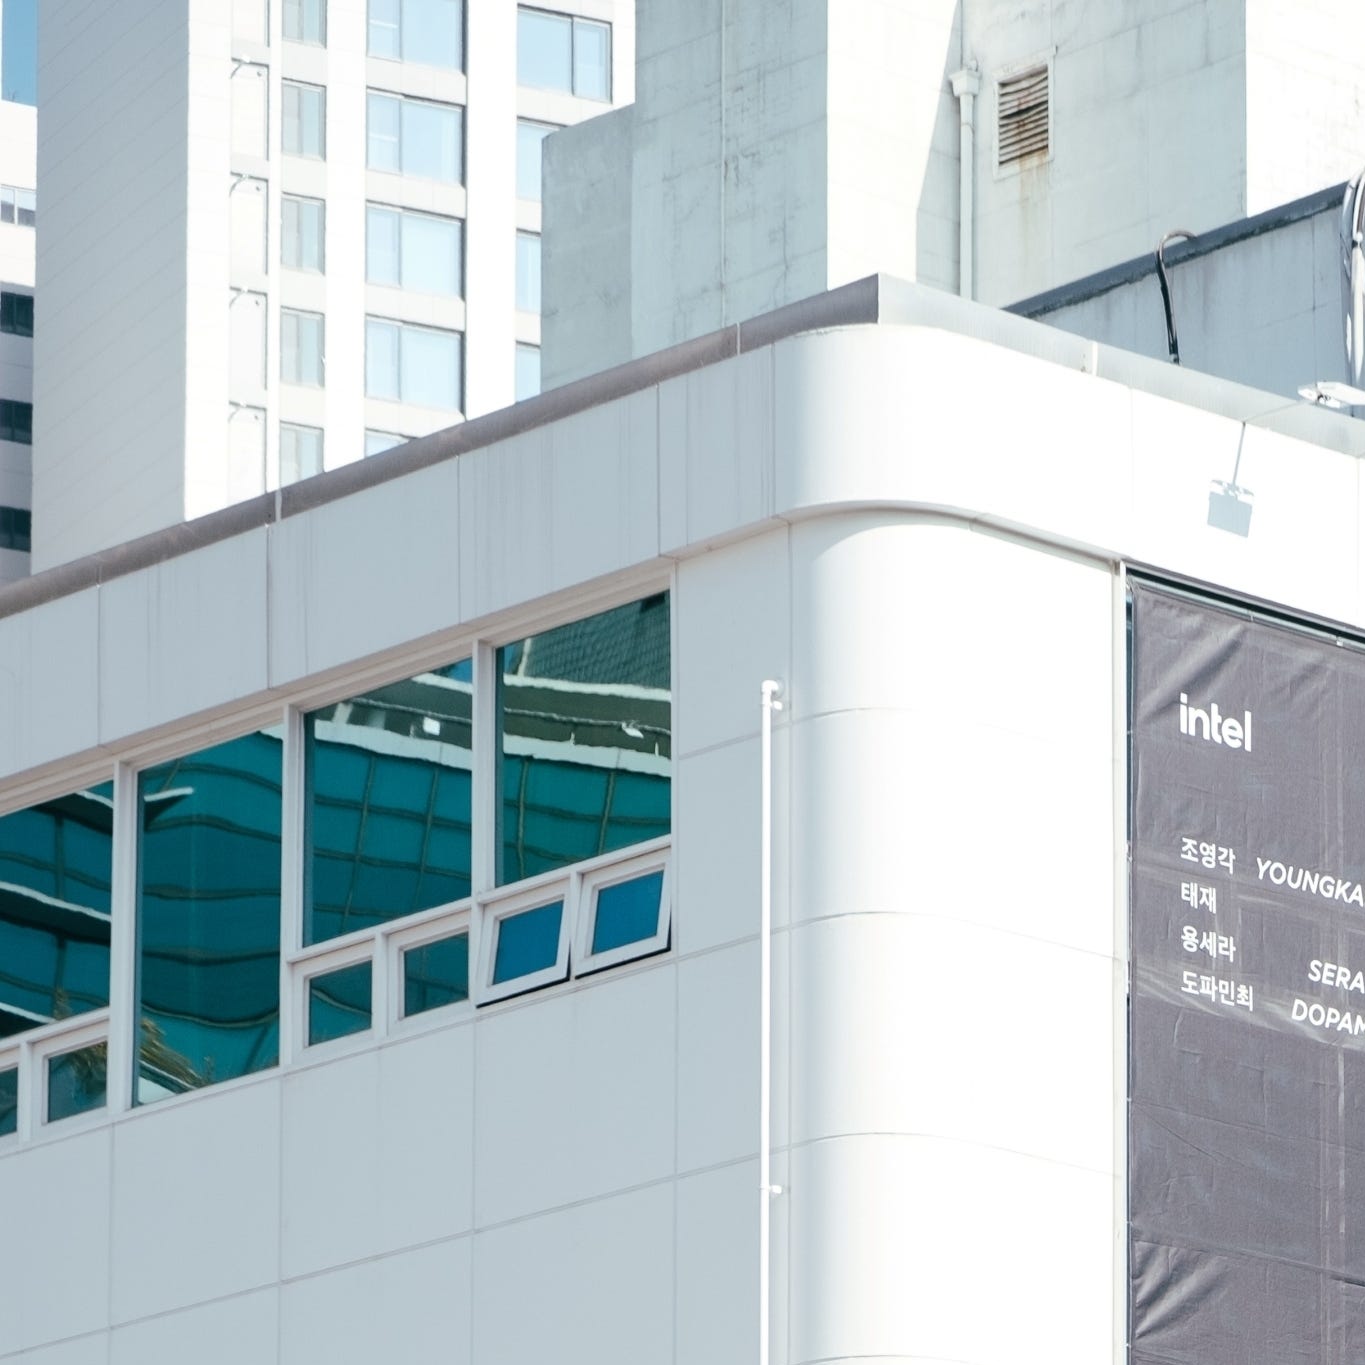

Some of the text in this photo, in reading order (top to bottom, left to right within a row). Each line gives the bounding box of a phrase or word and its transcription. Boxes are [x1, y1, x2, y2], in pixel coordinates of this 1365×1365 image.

[1179, 692, 1252, 752] intel
[1180, 837, 1236, 875] 조영각
[1181, 882, 1217, 914] 태재
[1181, 925, 1237, 963] 용세라
[1180, 970, 1254, 1012] 도파민최
